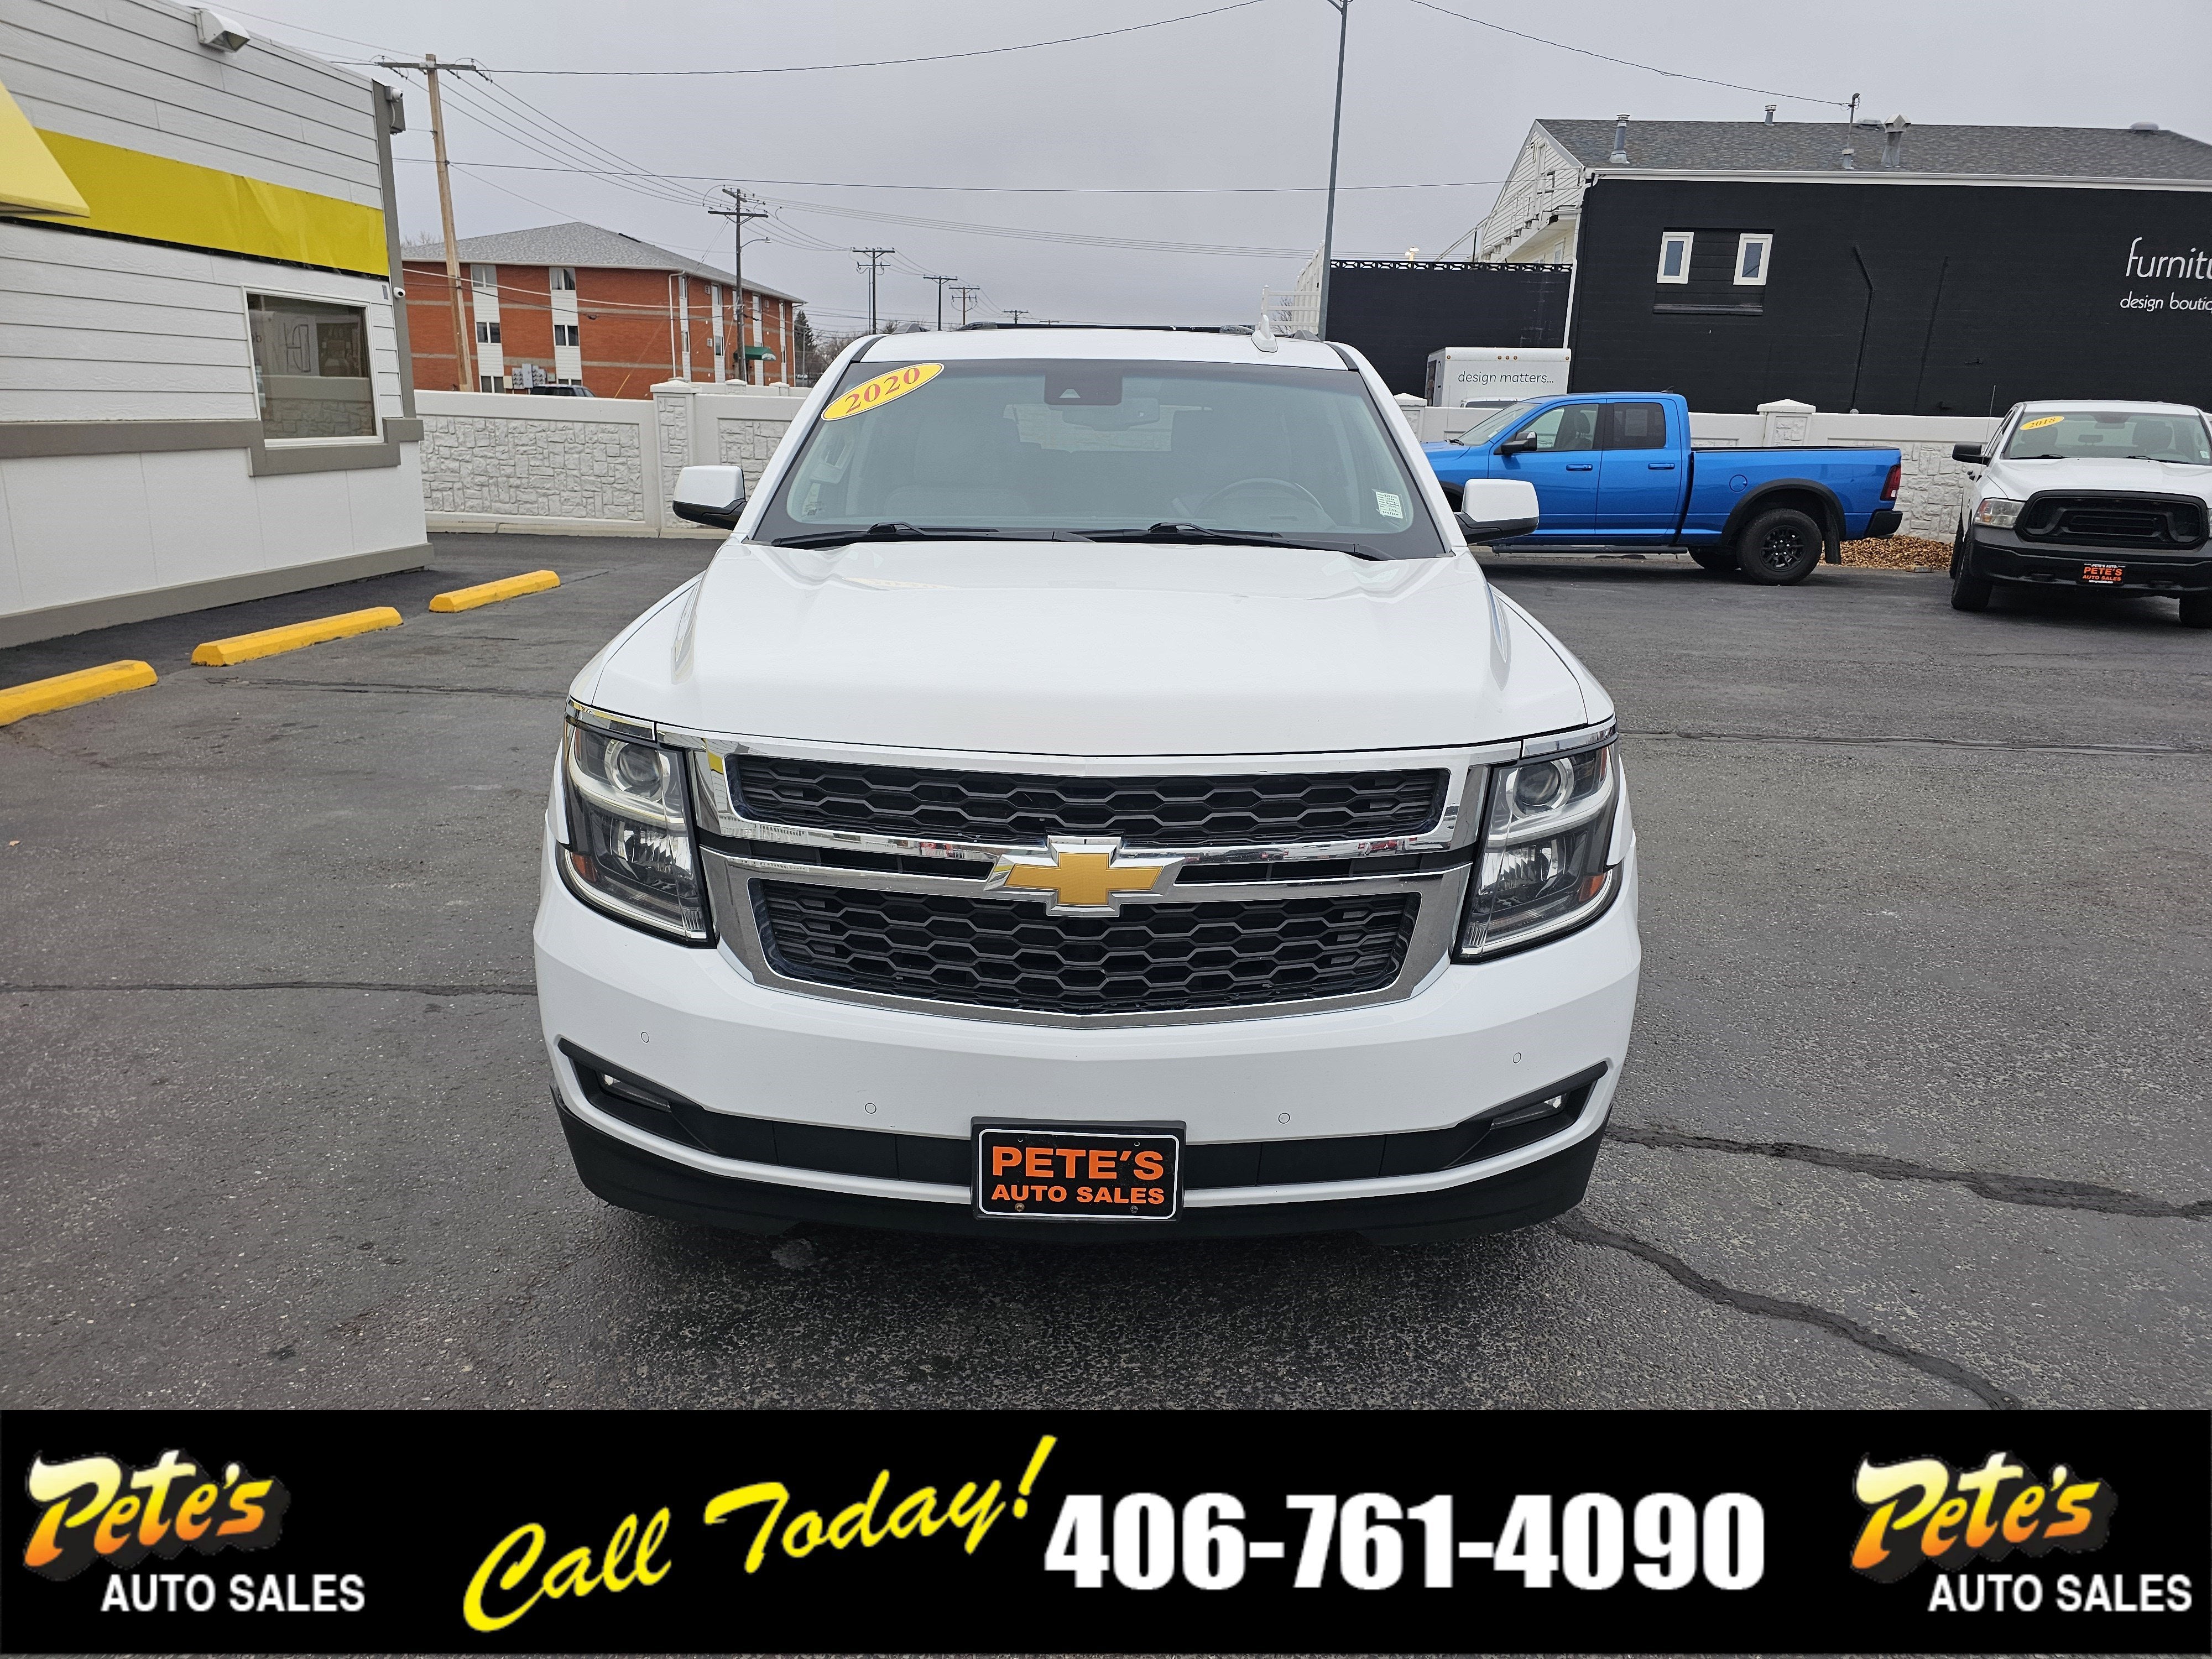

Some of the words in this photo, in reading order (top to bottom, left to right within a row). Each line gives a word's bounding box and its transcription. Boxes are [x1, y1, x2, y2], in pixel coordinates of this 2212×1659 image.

[2120, 290, 2164, 312] design
[1458, 371, 1496, 385] design
[1500, 373, 1554, 383] matters...
[844, 367, 920, 414] 2020
[2029, 418, 2056, 428] 2018
[2084, 567, 2122, 576] PETE'S
[993, 1146, 1164, 1181] PETE'S
[992, 1184, 1067, 1202] AUTO
[1077, 1186, 1165, 1204] SALES
